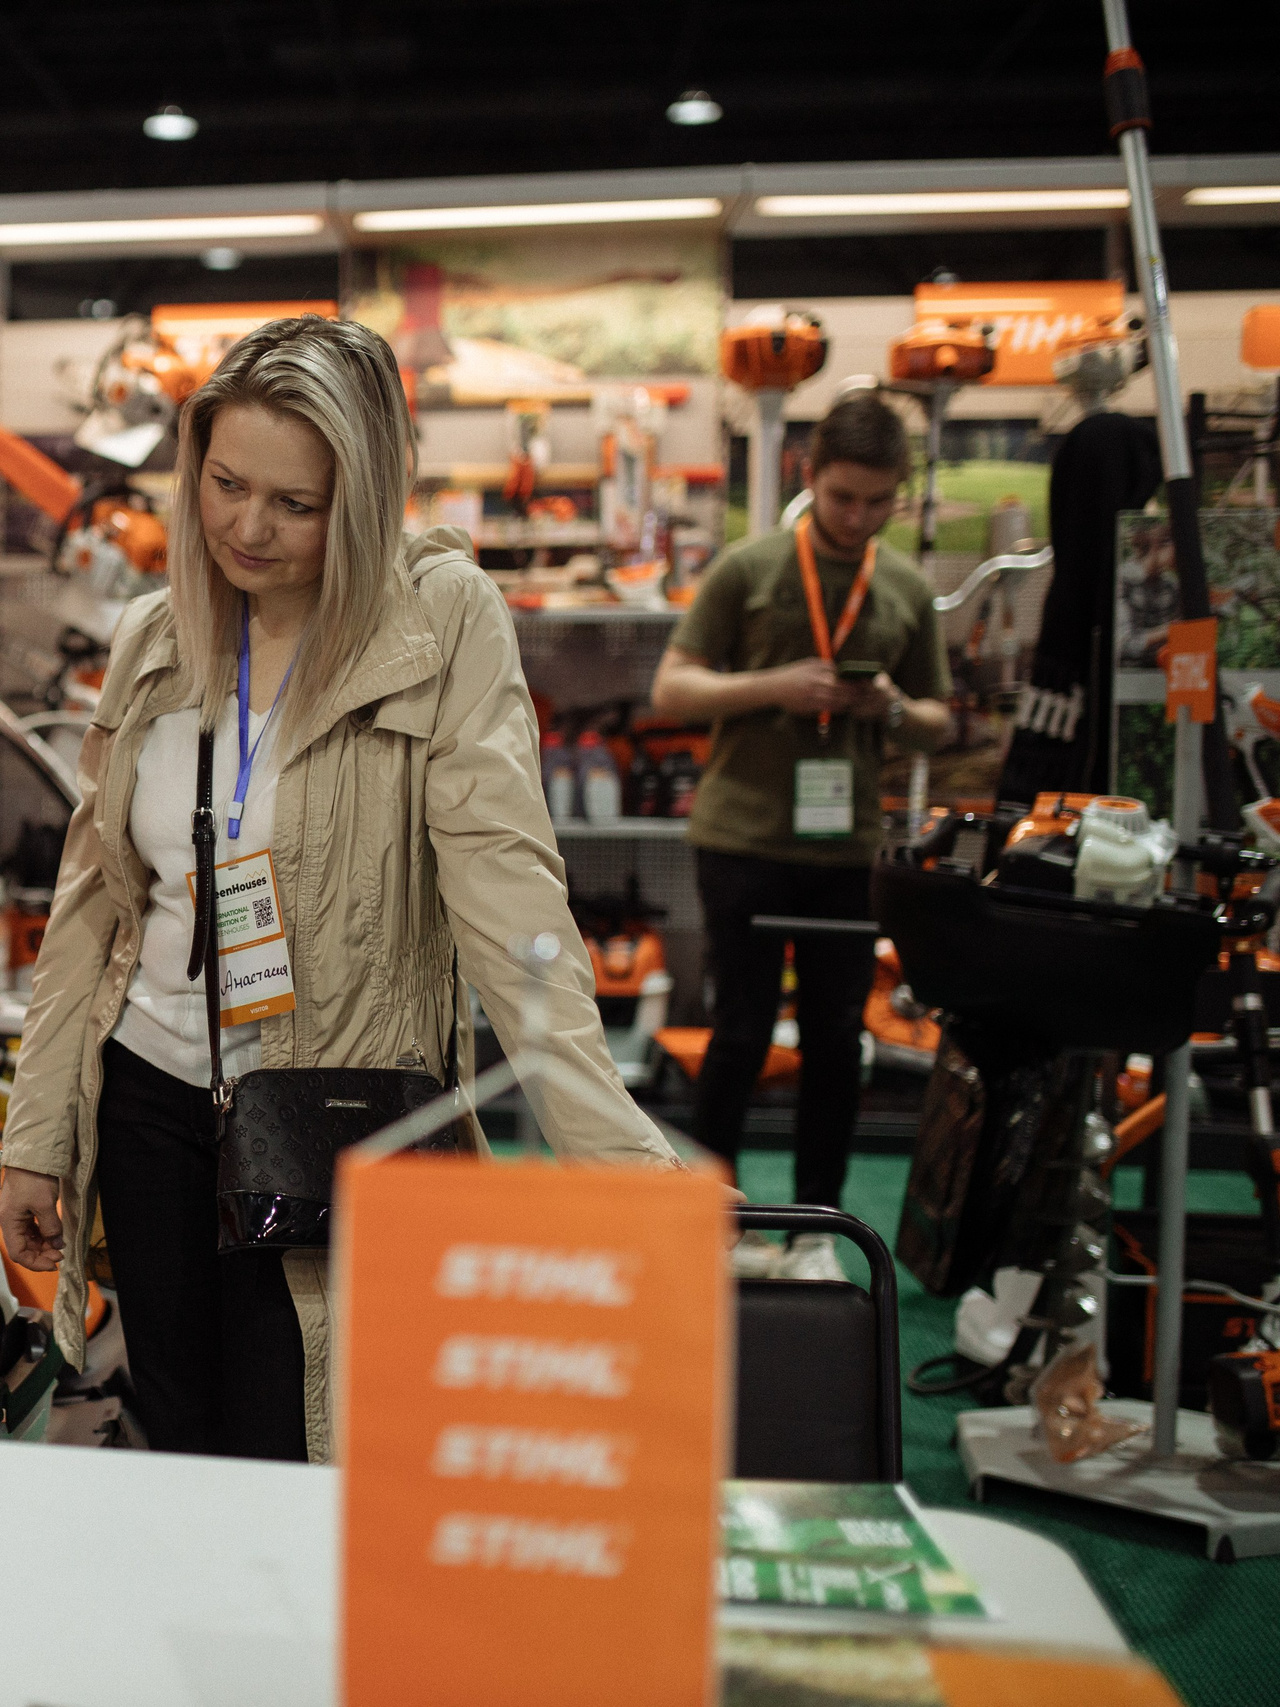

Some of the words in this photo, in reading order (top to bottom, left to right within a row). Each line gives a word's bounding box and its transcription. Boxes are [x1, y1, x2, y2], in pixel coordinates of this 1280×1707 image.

[214, 876, 267, 899] eenHouses
[240, 914, 248, 923] OF
[220, 964, 288, 996] Анастасия
[249, 1004, 269, 1014] VISITOR
